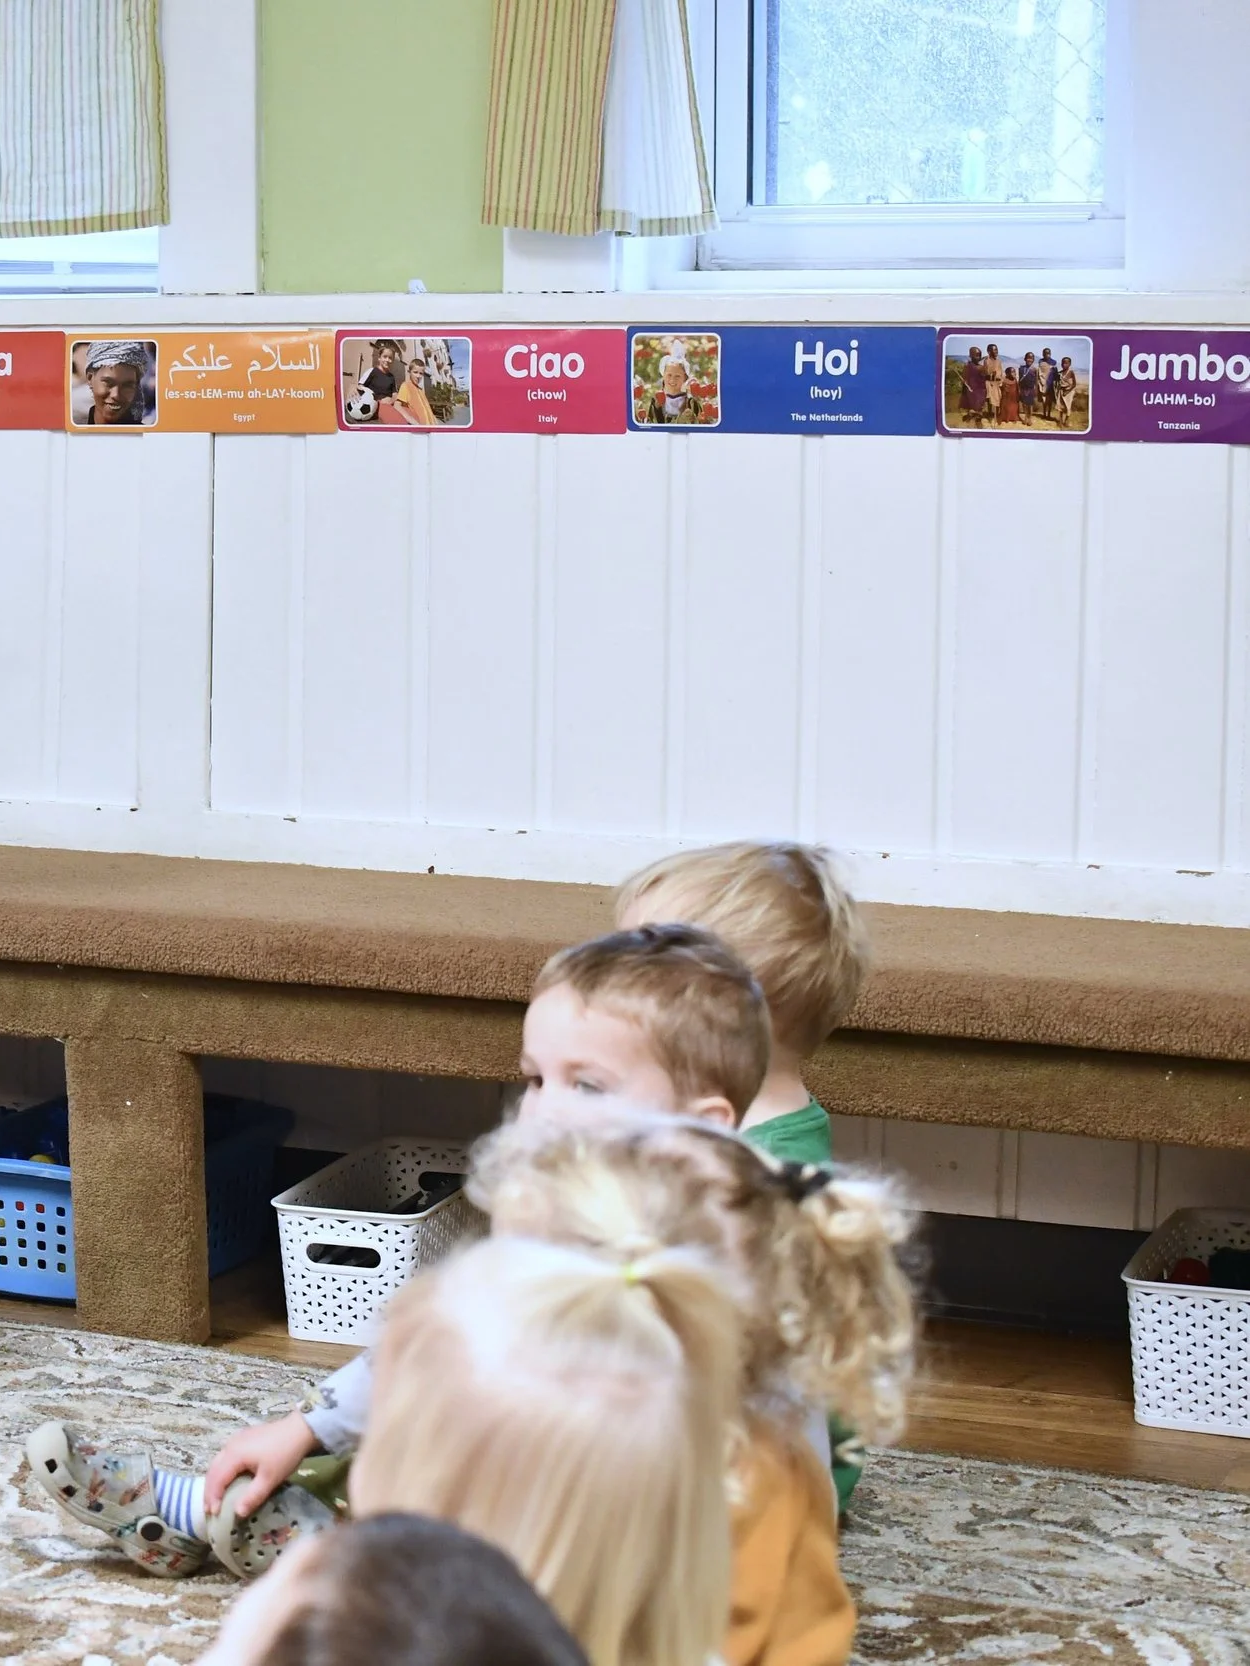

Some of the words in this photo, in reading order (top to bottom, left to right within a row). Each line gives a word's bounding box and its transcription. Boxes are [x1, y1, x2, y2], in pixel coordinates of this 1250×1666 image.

[168, 343, 233, 385] عليكم
[247, 343, 320, 385] السلام
[504, 343, 585, 378] Ciao
[794, 339, 859, 376] Hoi
[1110, 343, 1250, 382] Jambo
[165, 387, 244, 399] (es-sa-LEM-mu
[248, 387, 324, 400] ah-LAY-koom)
[527, 388, 567, 402] (chow)
[810, 385, 842, 401] (hoy)
[1142, 392, 1216, 407] (JAHM-bo)
[233, 413, 256, 421] Egypt
[538, 414, 558, 425] Italy
[790, 412, 807, 421] The
[809, 412, 863, 422] Netherlands
[1157, 420, 1201, 430] Tanzania
